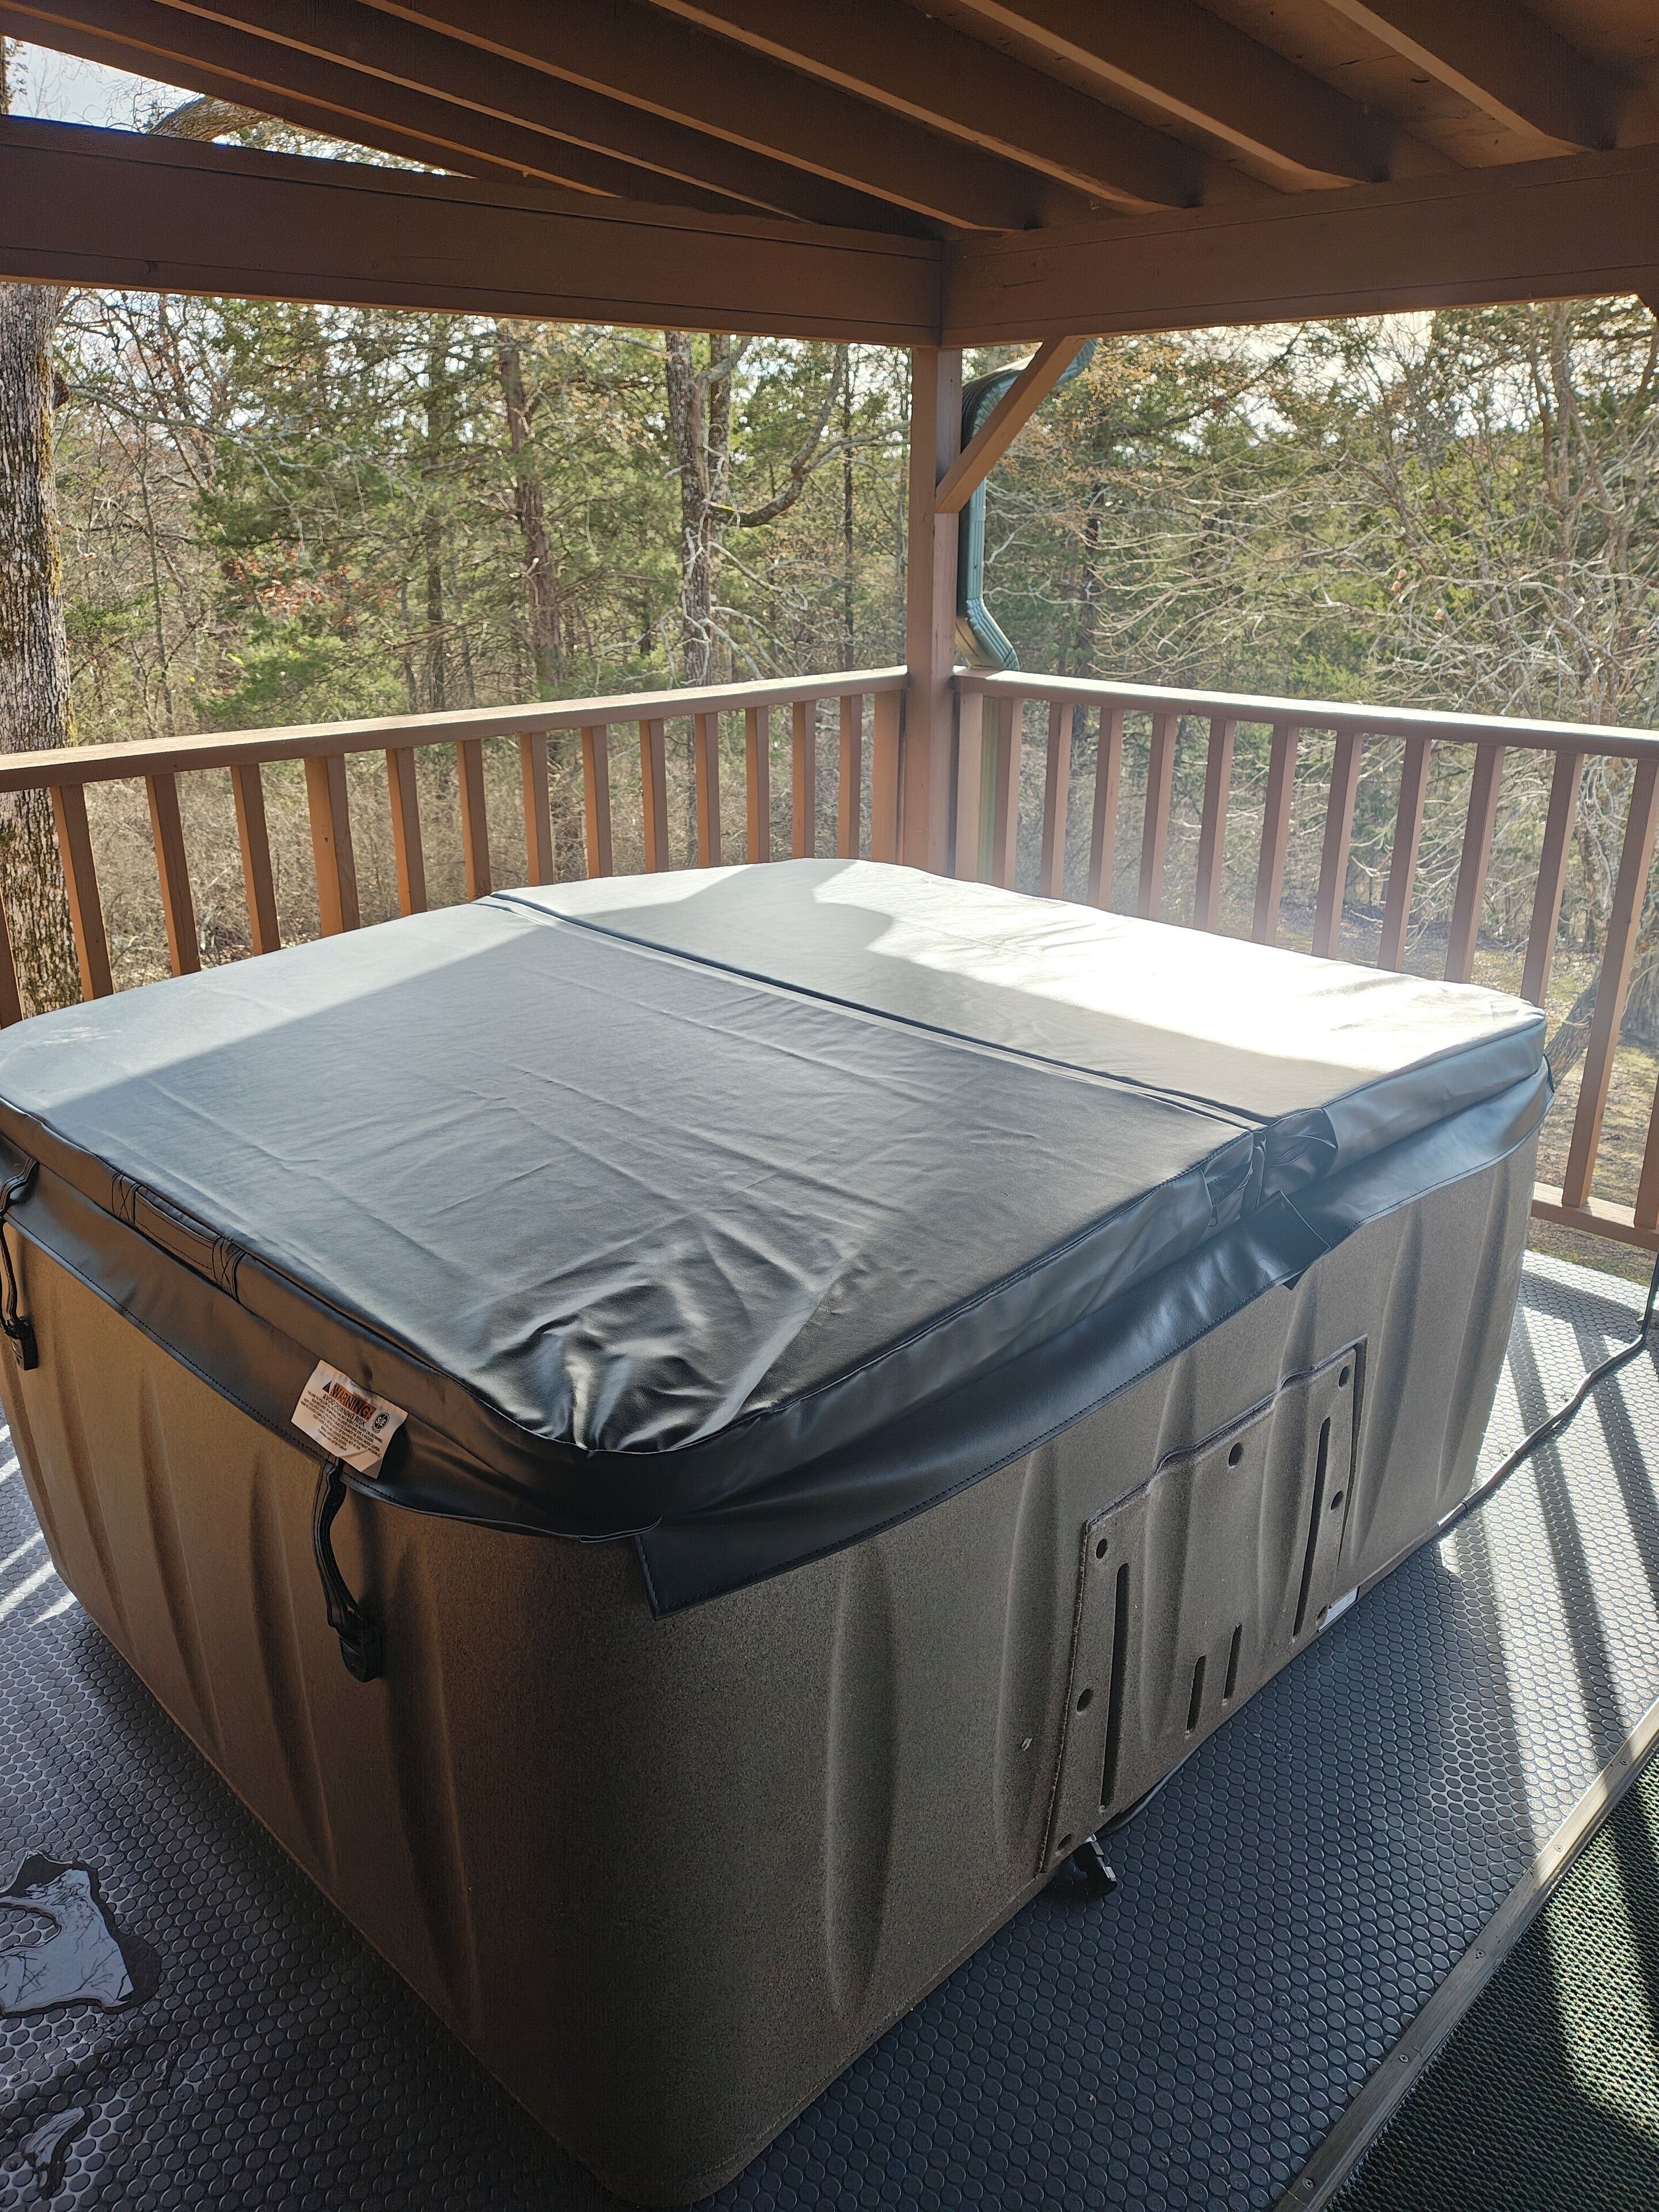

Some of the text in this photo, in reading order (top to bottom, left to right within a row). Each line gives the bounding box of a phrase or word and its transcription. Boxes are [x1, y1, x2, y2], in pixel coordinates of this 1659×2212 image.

[322, 1394, 335, 1405] AVOID
[334, 1401, 354, 1419] DROWNING
[354, 1414, 367, 1427] RISK
[332, 1385, 373, 1419] WARNING!
